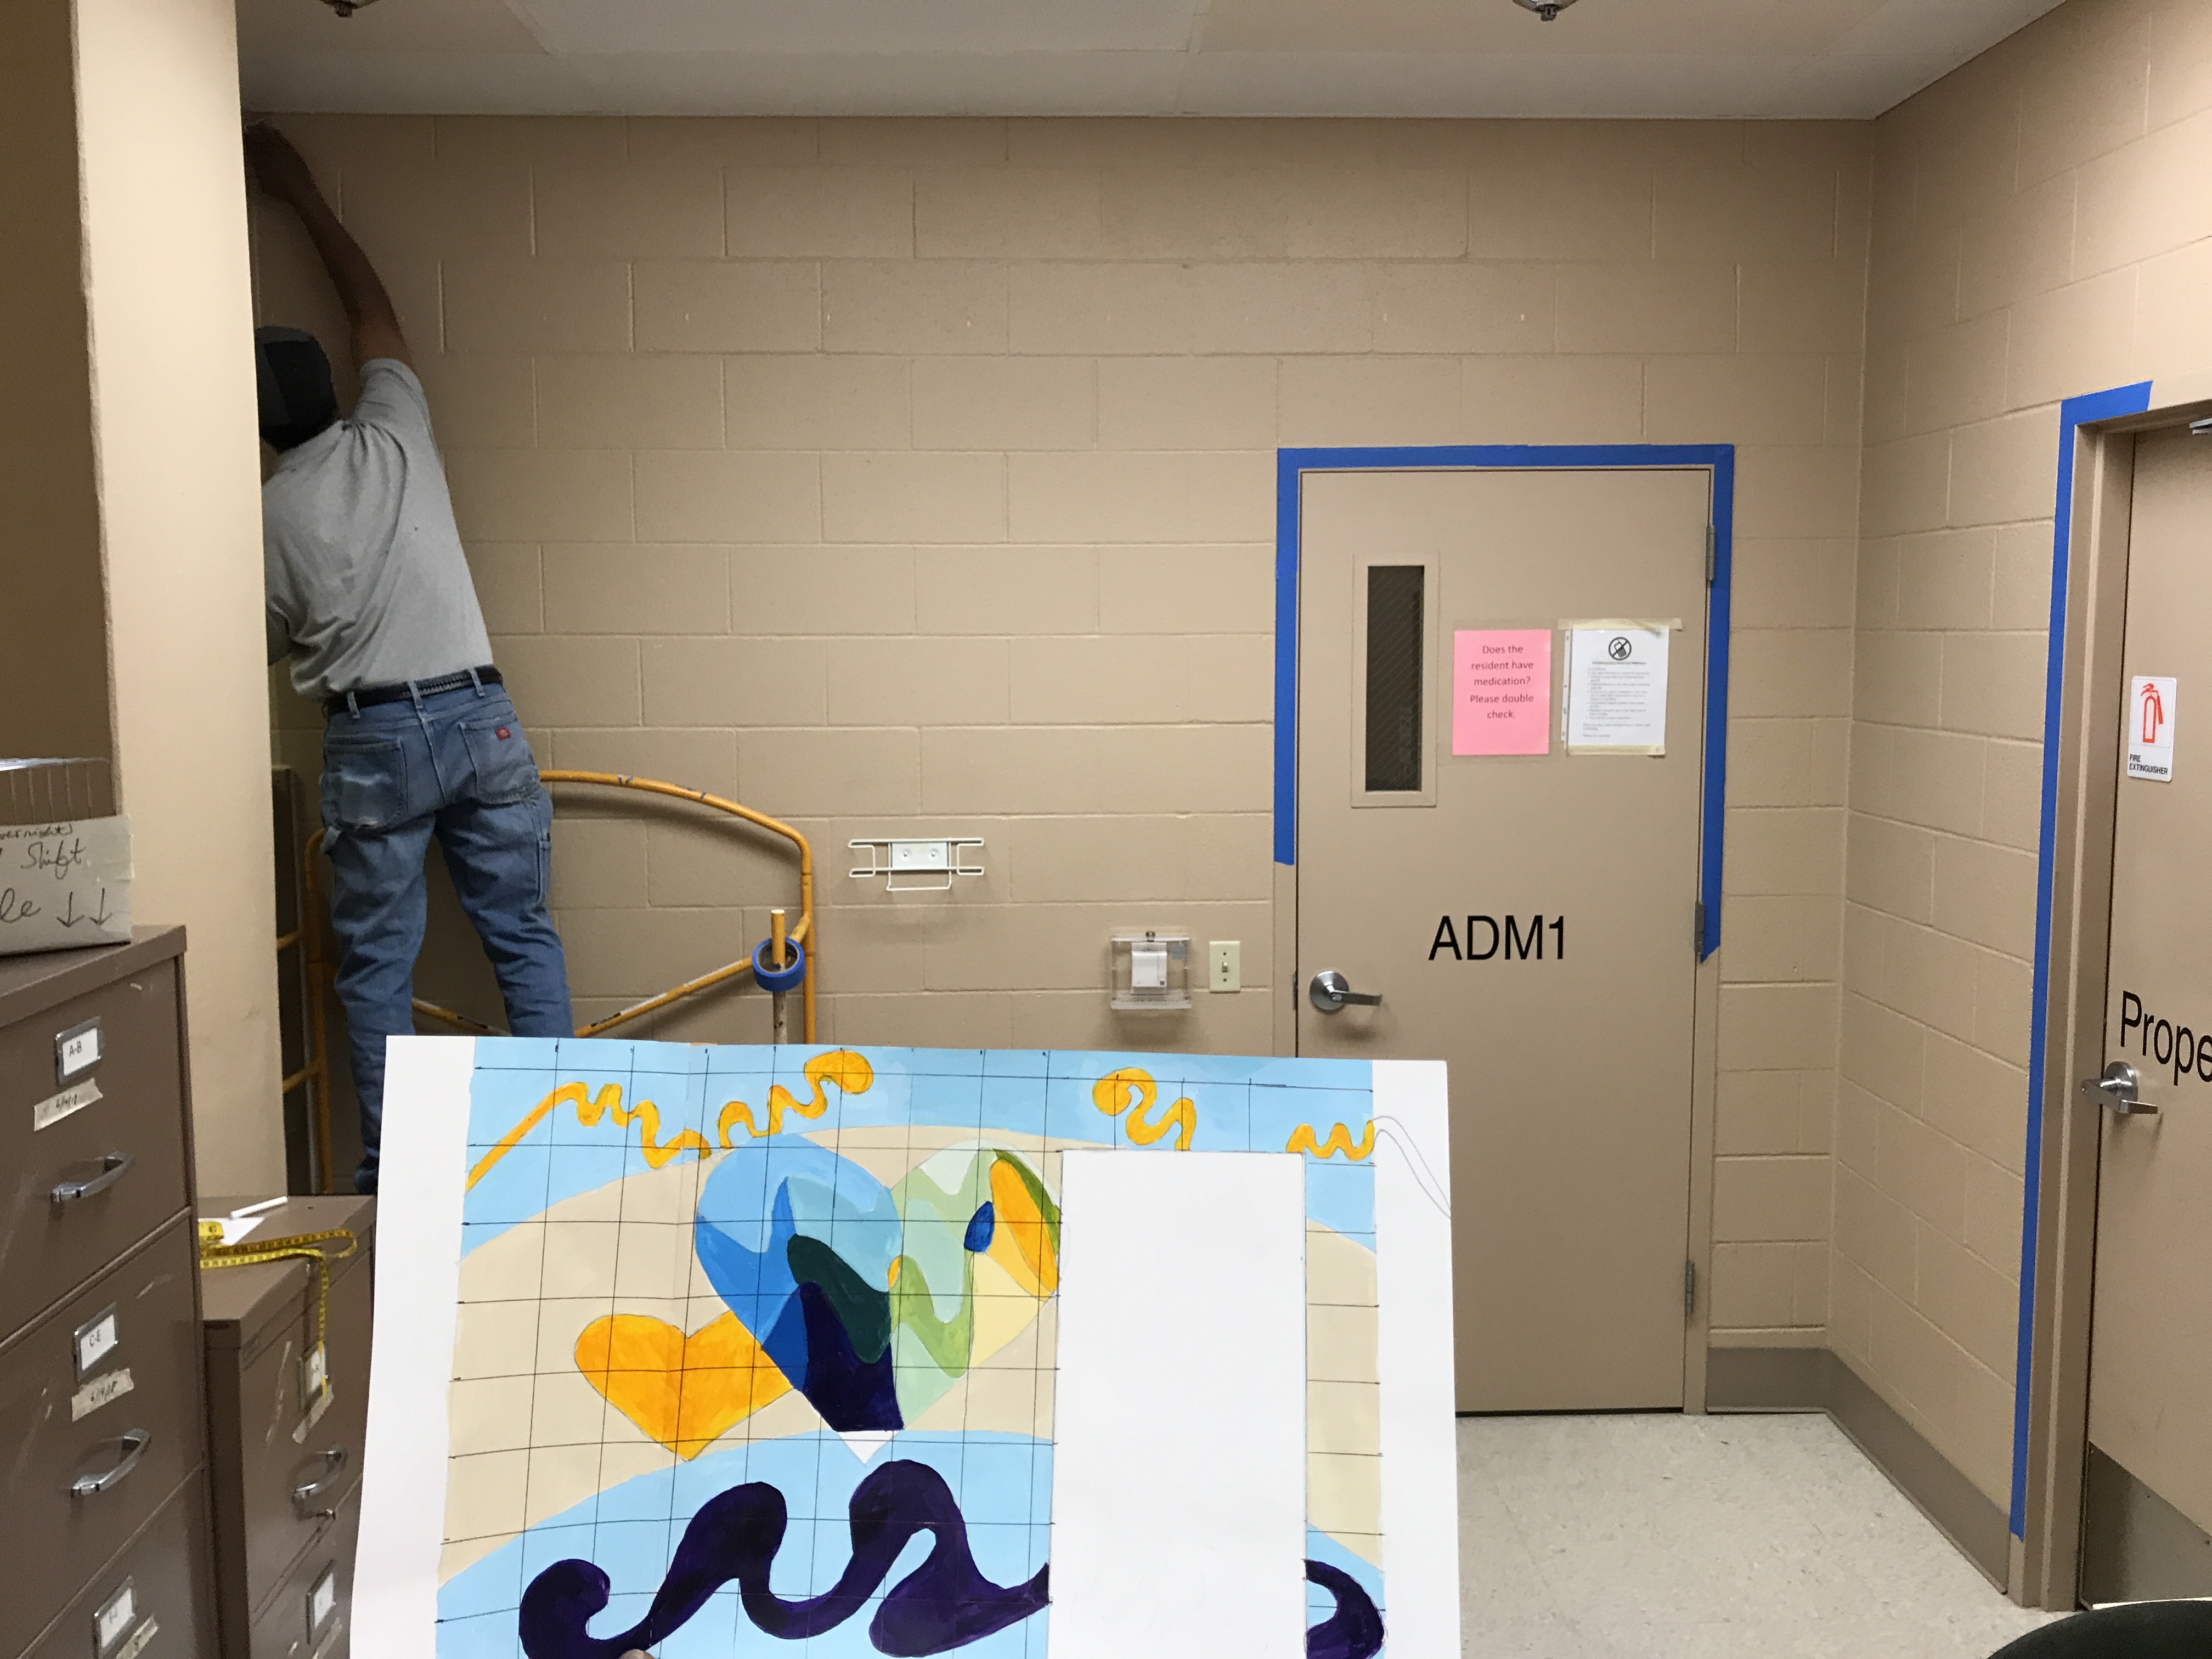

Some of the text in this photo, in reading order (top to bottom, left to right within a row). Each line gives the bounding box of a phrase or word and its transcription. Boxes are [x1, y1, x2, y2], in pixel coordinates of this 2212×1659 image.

[1482, 645, 1523, 654] Does the
[1471, 661, 1534, 670] resident have
[1474, 676, 1531, 686] medication?
[1470, 693, 1534, 703] Please double
[1487, 710, 1516, 719] check.
[2129, 754, 2141, 762] FIRE
[2129, 763, 2168, 775] EXTINGUISHER
[20, 838, 86, 880] Shift
[1428, 915, 1564, 961] ADM1
[2120, 990, 2212, 1086] Prope
